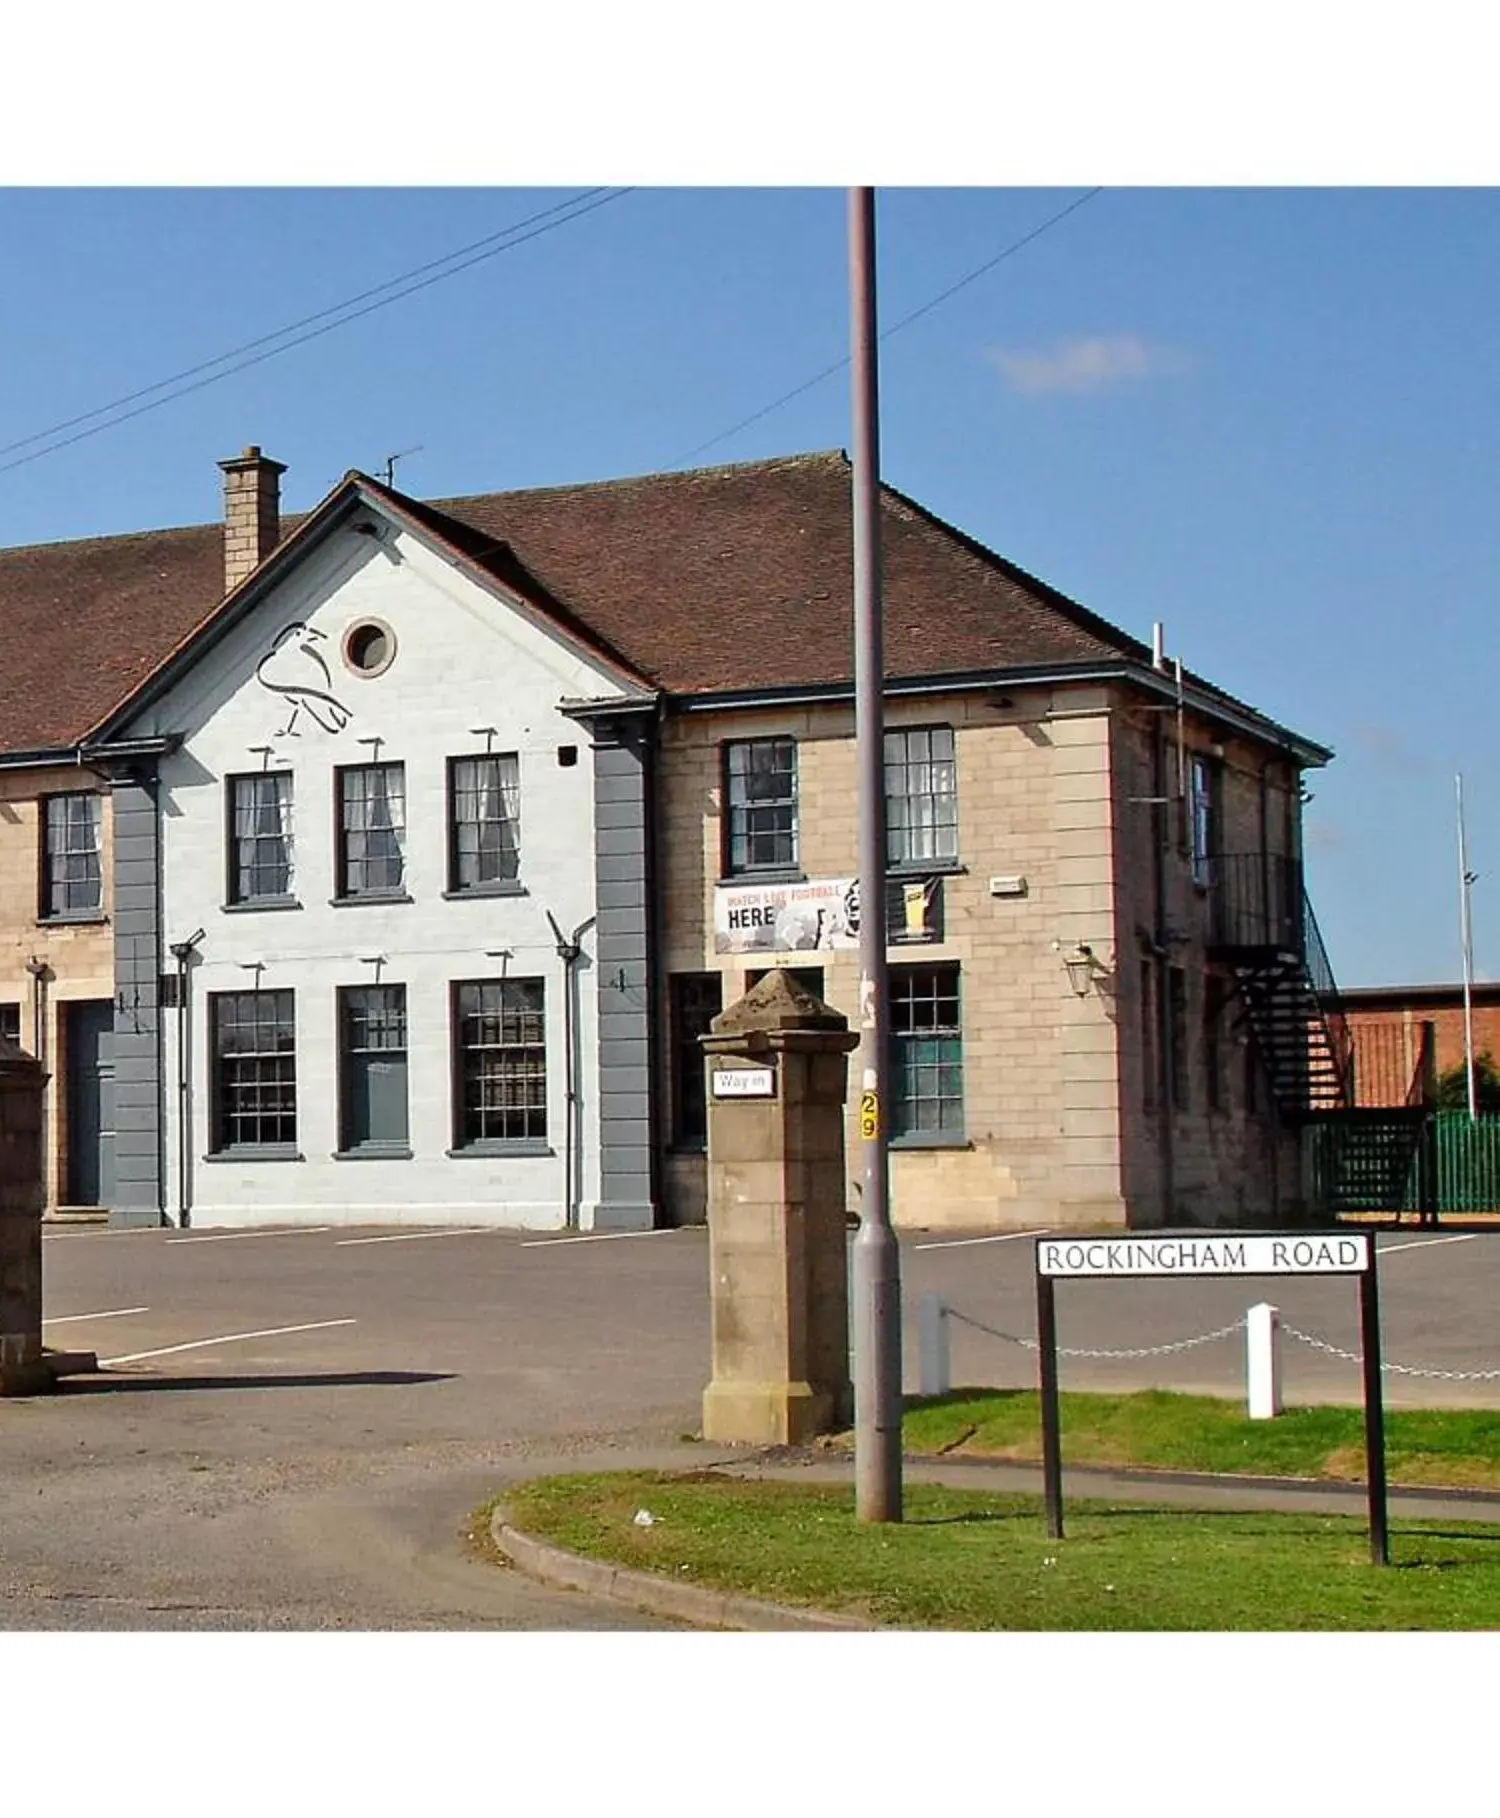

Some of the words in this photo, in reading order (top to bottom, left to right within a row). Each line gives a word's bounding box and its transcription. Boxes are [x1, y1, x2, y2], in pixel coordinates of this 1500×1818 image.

[728, 905, 775, 929] HERE
[719, 1074, 749, 1090] Way
[1046, 1243, 1247, 1270] ROCKINGHAM
[1272, 1240, 1358, 1268] ROAD
